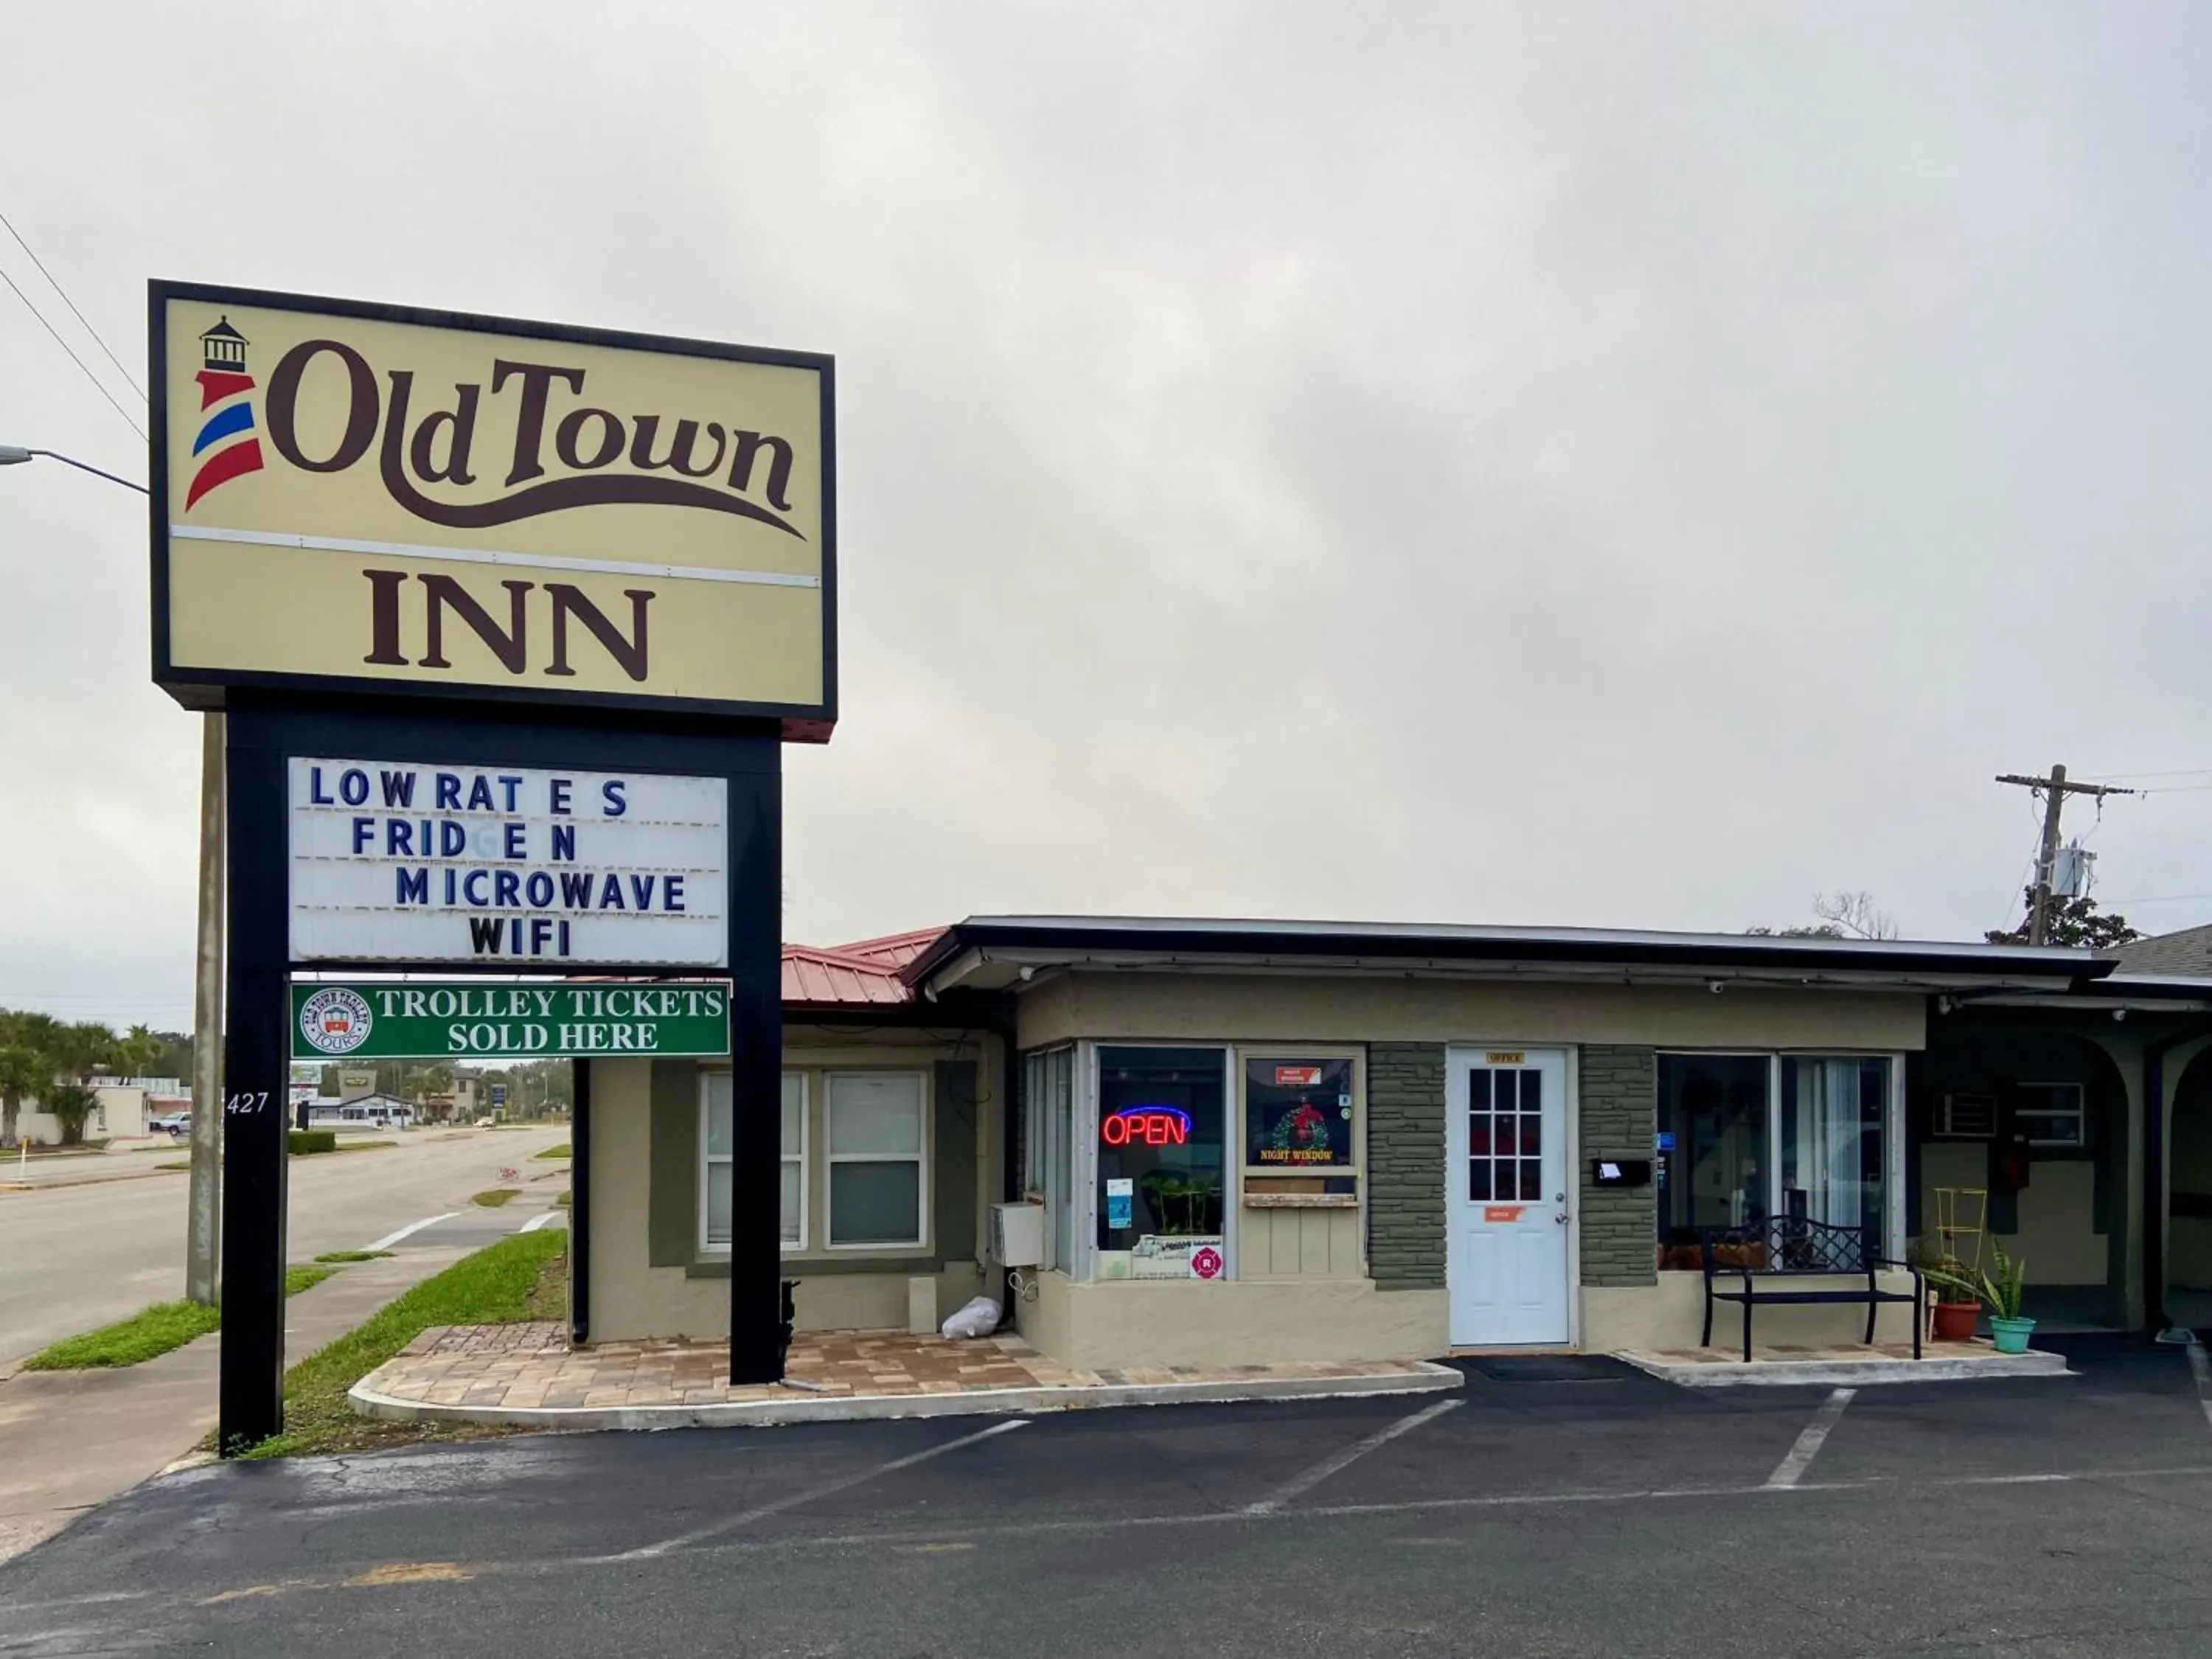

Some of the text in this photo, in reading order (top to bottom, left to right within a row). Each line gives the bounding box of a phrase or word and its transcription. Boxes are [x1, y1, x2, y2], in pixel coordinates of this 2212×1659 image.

[265, 338, 794, 528] Old Town
[363, 569, 656, 682] INN
[310, 766, 627, 817] LOW RATES
[396, 866, 686, 911] MICROWAVE
[470, 917, 571, 957] WIFI
[340, 992, 368, 1024] TROLLEY
[375, 989, 724, 1019] TROLLEY TICKETS
[315, 1033, 360, 1048] TOURS
[448, 1022, 659, 1051] SOLD HERE
[1489, 1054, 1521, 1062] OFFICE
[227, 1092, 269, 1114] 427
[1103, 1115, 1187, 1144] OPEN
[1260, 1150, 1333, 1161] NIGHT WINDOW
[1203, 1259, 1211, 1267] R
